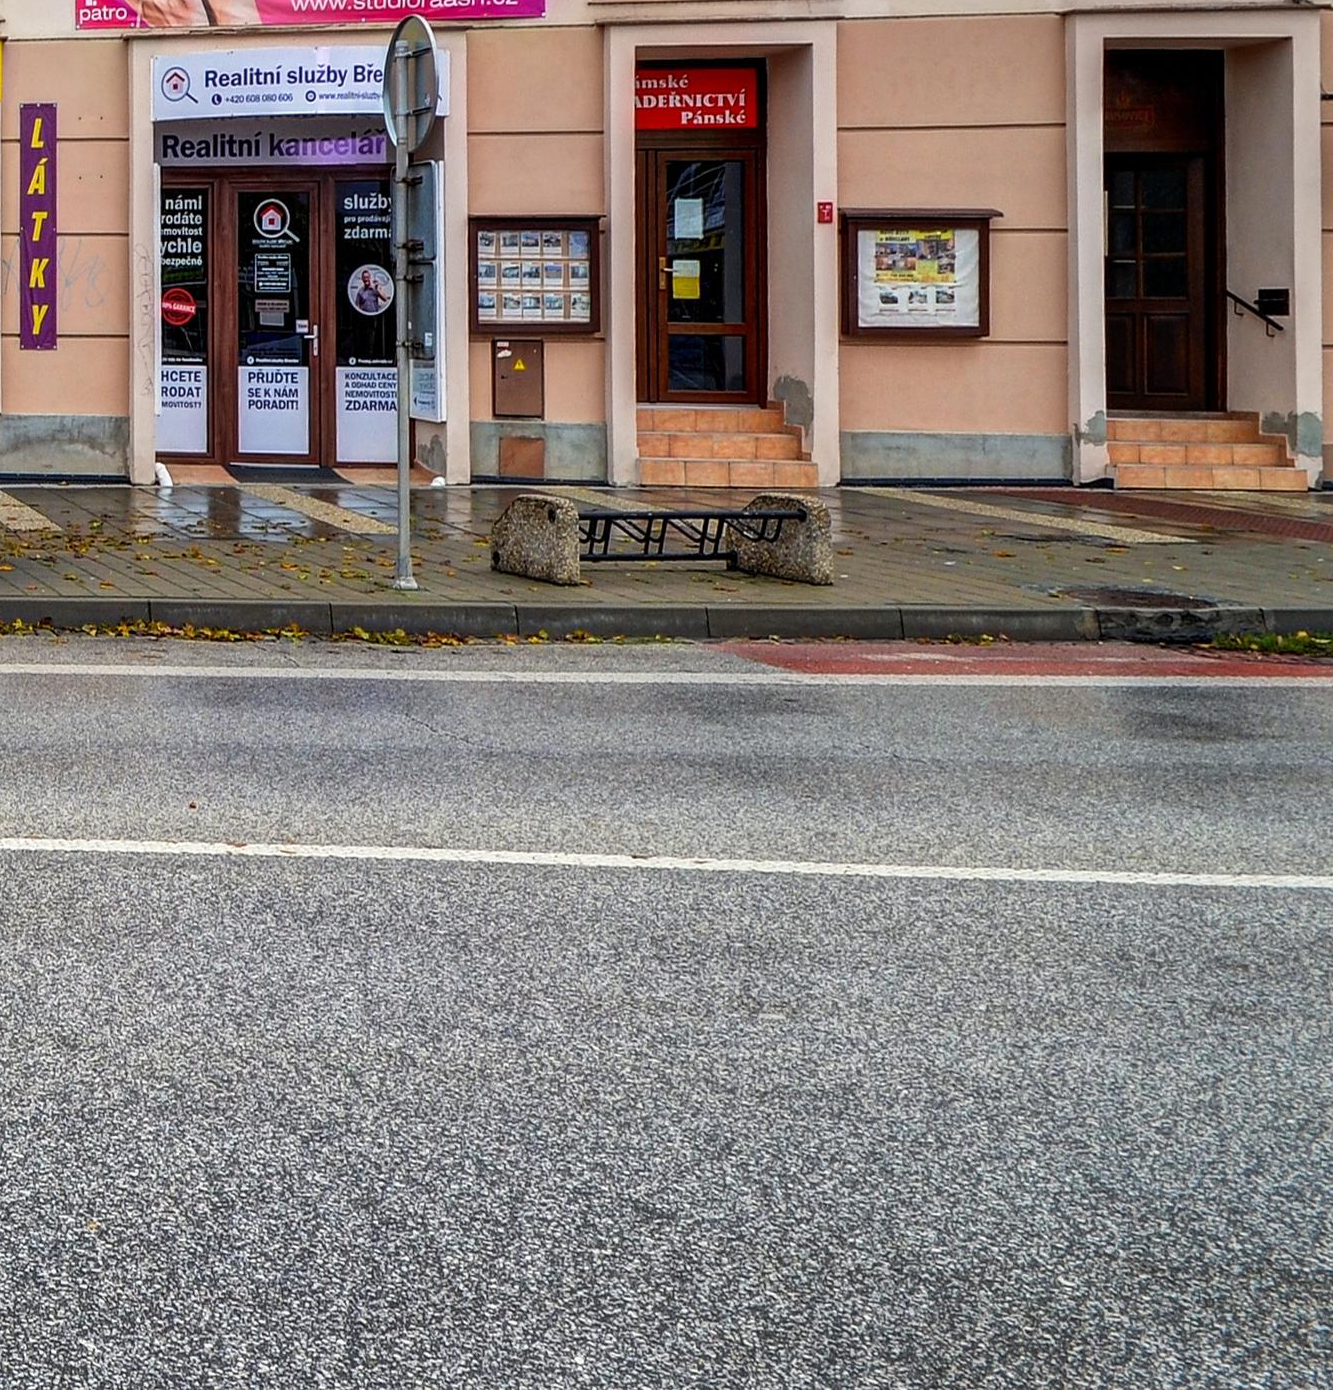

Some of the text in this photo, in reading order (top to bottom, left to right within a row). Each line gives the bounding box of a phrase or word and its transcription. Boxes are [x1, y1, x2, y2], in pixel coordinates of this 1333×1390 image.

[79, 5, 128, 24] patro
[204, 63, 383, 88] Realitní služby Bře
[635, 74, 689, 89] mské
[225, 95, 244, 104] +420
[245, 94, 260, 103] 608
[278, 93, 293, 102] 606
[634, 88, 746, 108] ADEŘNICTVÍ
[680, 109, 746, 125] Pánské
[162, 128, 386, 159] Realitní kancelář
[165, 195, 202, 210] námi
[161, 212, 202, 225] rodáte
[27, 118, 49, 335] LÁTKY
[161, 227, 203, 236] movitost
[161, 238, 202, 255] ychle
[161, 370, 201, 383] HCETE
[248, 368, 299, 384] PŘIJĎTE
[344, 372, 397, 380] KONZULTACE
[248, 385, 299, 398] SE K NÁM
[353, 381, 376, 389] ODHAD
[378, 381, 397, 389] CENY
[161, 386, 202, 398] RODAT
[161, 400, 202, 409] MOVITOST?
[248, 399, 299, 410] PORADIT!
[344, 400, 398, 411] ZDARMA
